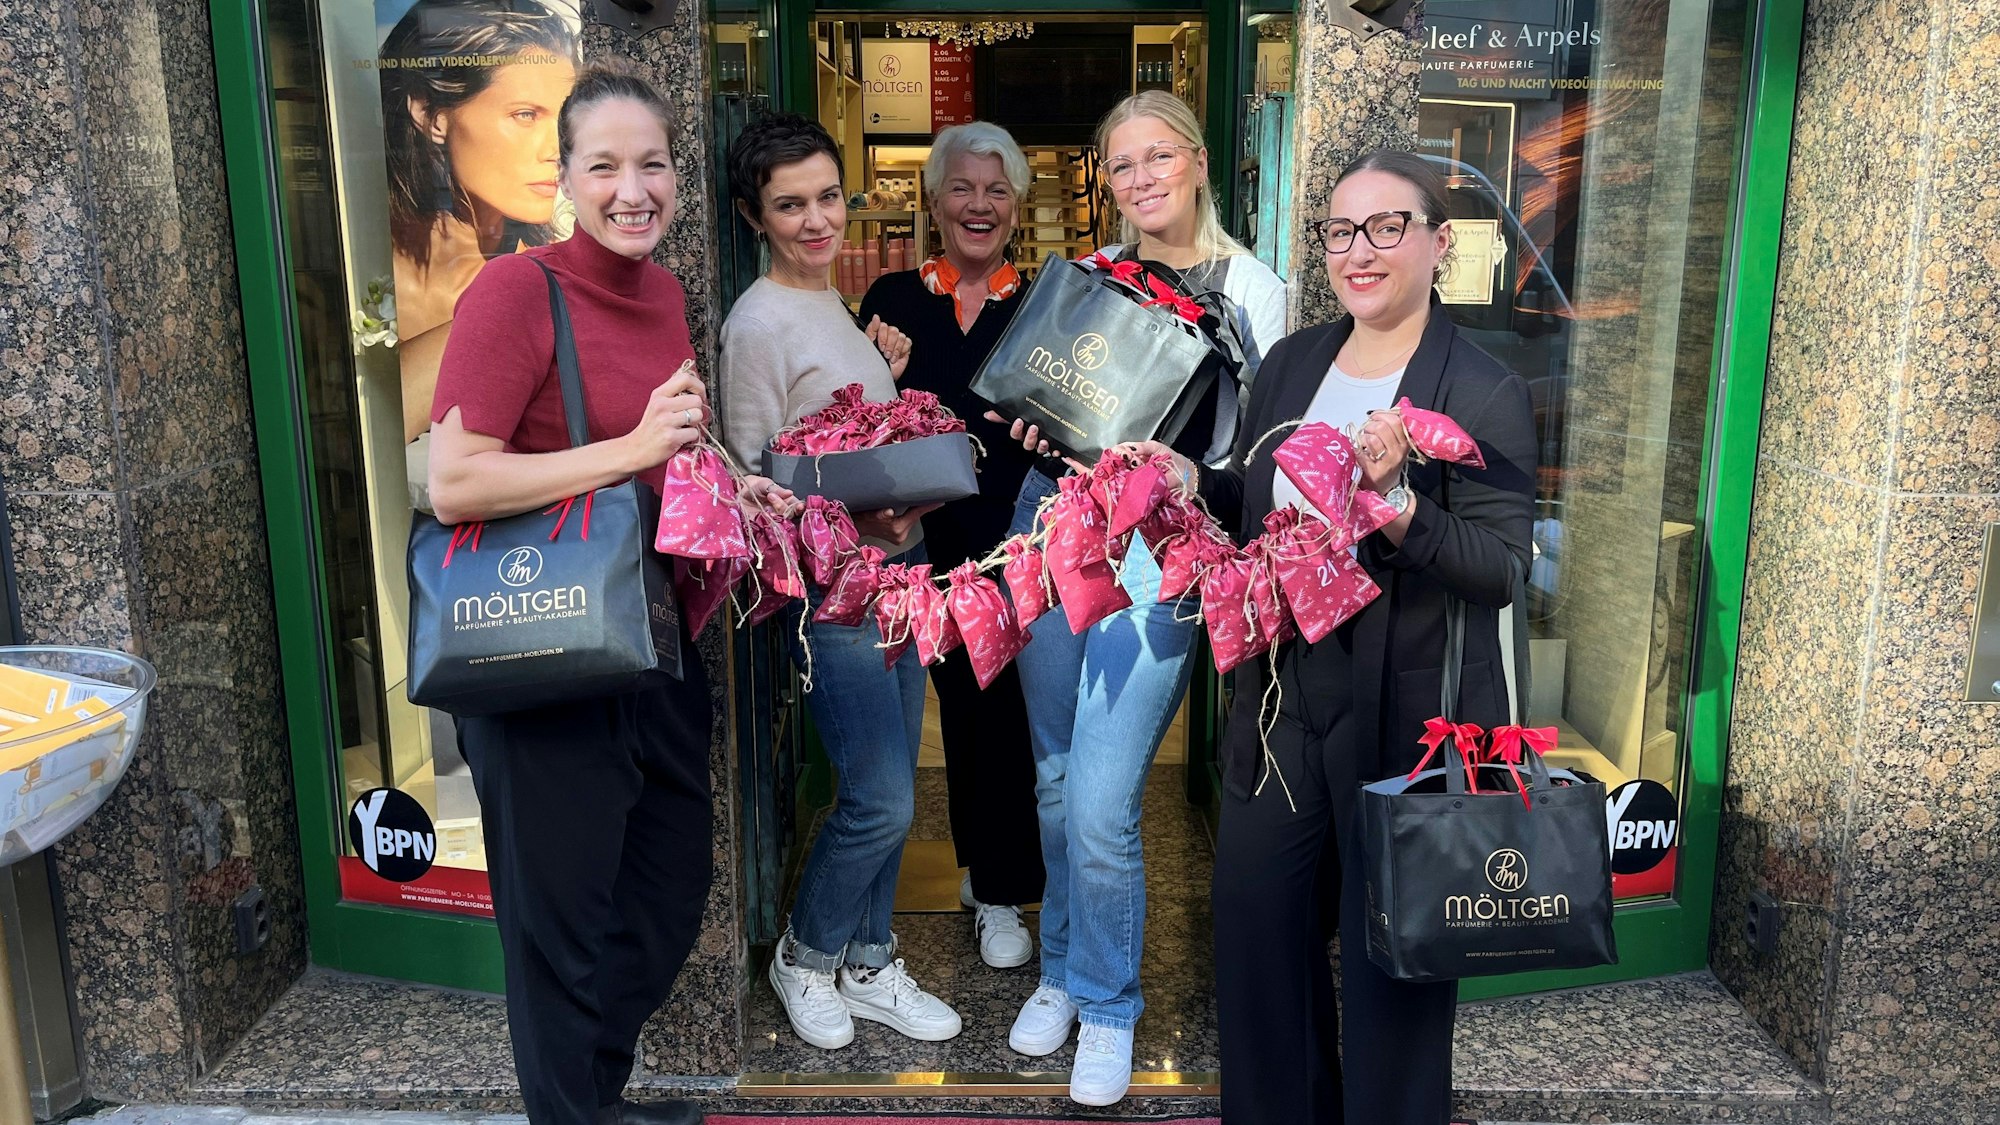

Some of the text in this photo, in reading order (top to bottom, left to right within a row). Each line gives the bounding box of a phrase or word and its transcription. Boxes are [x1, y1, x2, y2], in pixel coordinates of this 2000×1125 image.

[1488, 27, 1507, 48] &
[1514, 22, 1601, 55] Arpels
[352, 53, 558, 69] TAG UND NACHT VIDEOÜBERWACHUNG
[1460, 60, 1534, 70] PARFUMERIE
[1457, 75, 1665, 90] TAG UND NACHT VIDEOÜBERWACHUNG
[1024, 363, 1056, 387] PARFÜMERIE
[1060, 387, 1111, 421] BEAUTY-AKADEMIE
[1027, 346, 1120, 415] MÖLTGEN
[1325, 440, 1349, 466] 23
[1080, 510, 1094, 528] 14
[1190, 560, 1204, 574] 18
[1317, 558, 1340, 587] 21
[454, 585, 587, 623] MÖLTGEN
[861, 592, 873, 605] 8
[454, 619, 503, 632] PARFÜMERIE
[513, 608, 587, 624] BEAUTY-AKADEMIE
[996, 608, 1011, 631] 11
[400, 884, 447, 896] ÖFFNUNGSZEITEN:
[1445, 893, 1570, 920] MÖLTGEN
[1445, 920, 1493, 928] PARFÜMERIE
[1501, 917, 1570, 928] BEAUTY-AKADEMIE
